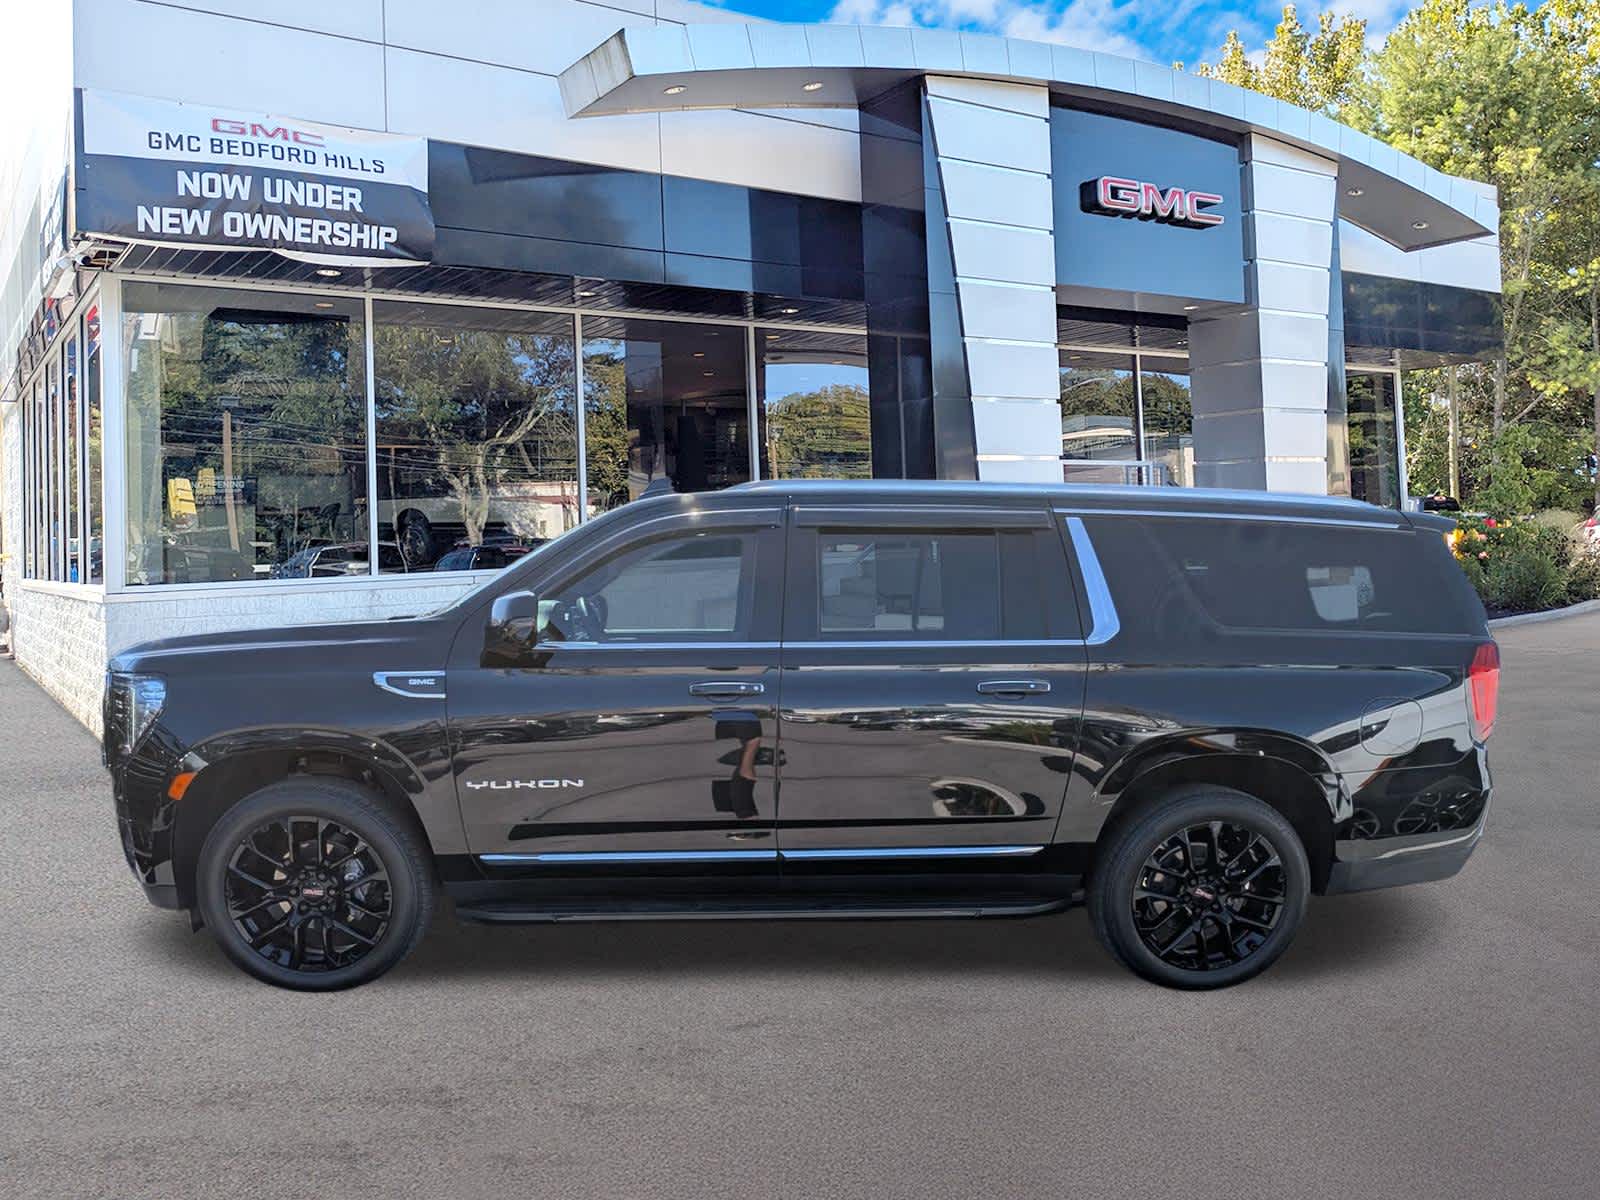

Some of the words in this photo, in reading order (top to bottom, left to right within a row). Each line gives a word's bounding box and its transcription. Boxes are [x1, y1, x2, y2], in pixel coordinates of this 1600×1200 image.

[148, 131, 201, 152] GMC
[210, 137, 316, 165] BEDFORD
[325, 152, 385, 174] HILLS
[211, 117, 326, 148] GMC
[177, 170, 252, 200] NOW
[263, 177, 363, 212] UNDER
[1097, 175, 1225, 225] GMC
[137, 205, 211, 235] NEW
[223, 211, 398, 250] OWNERSHIP
[408, 678, 436, 686] GMC
[465, 778, 585, 790] YUKON
